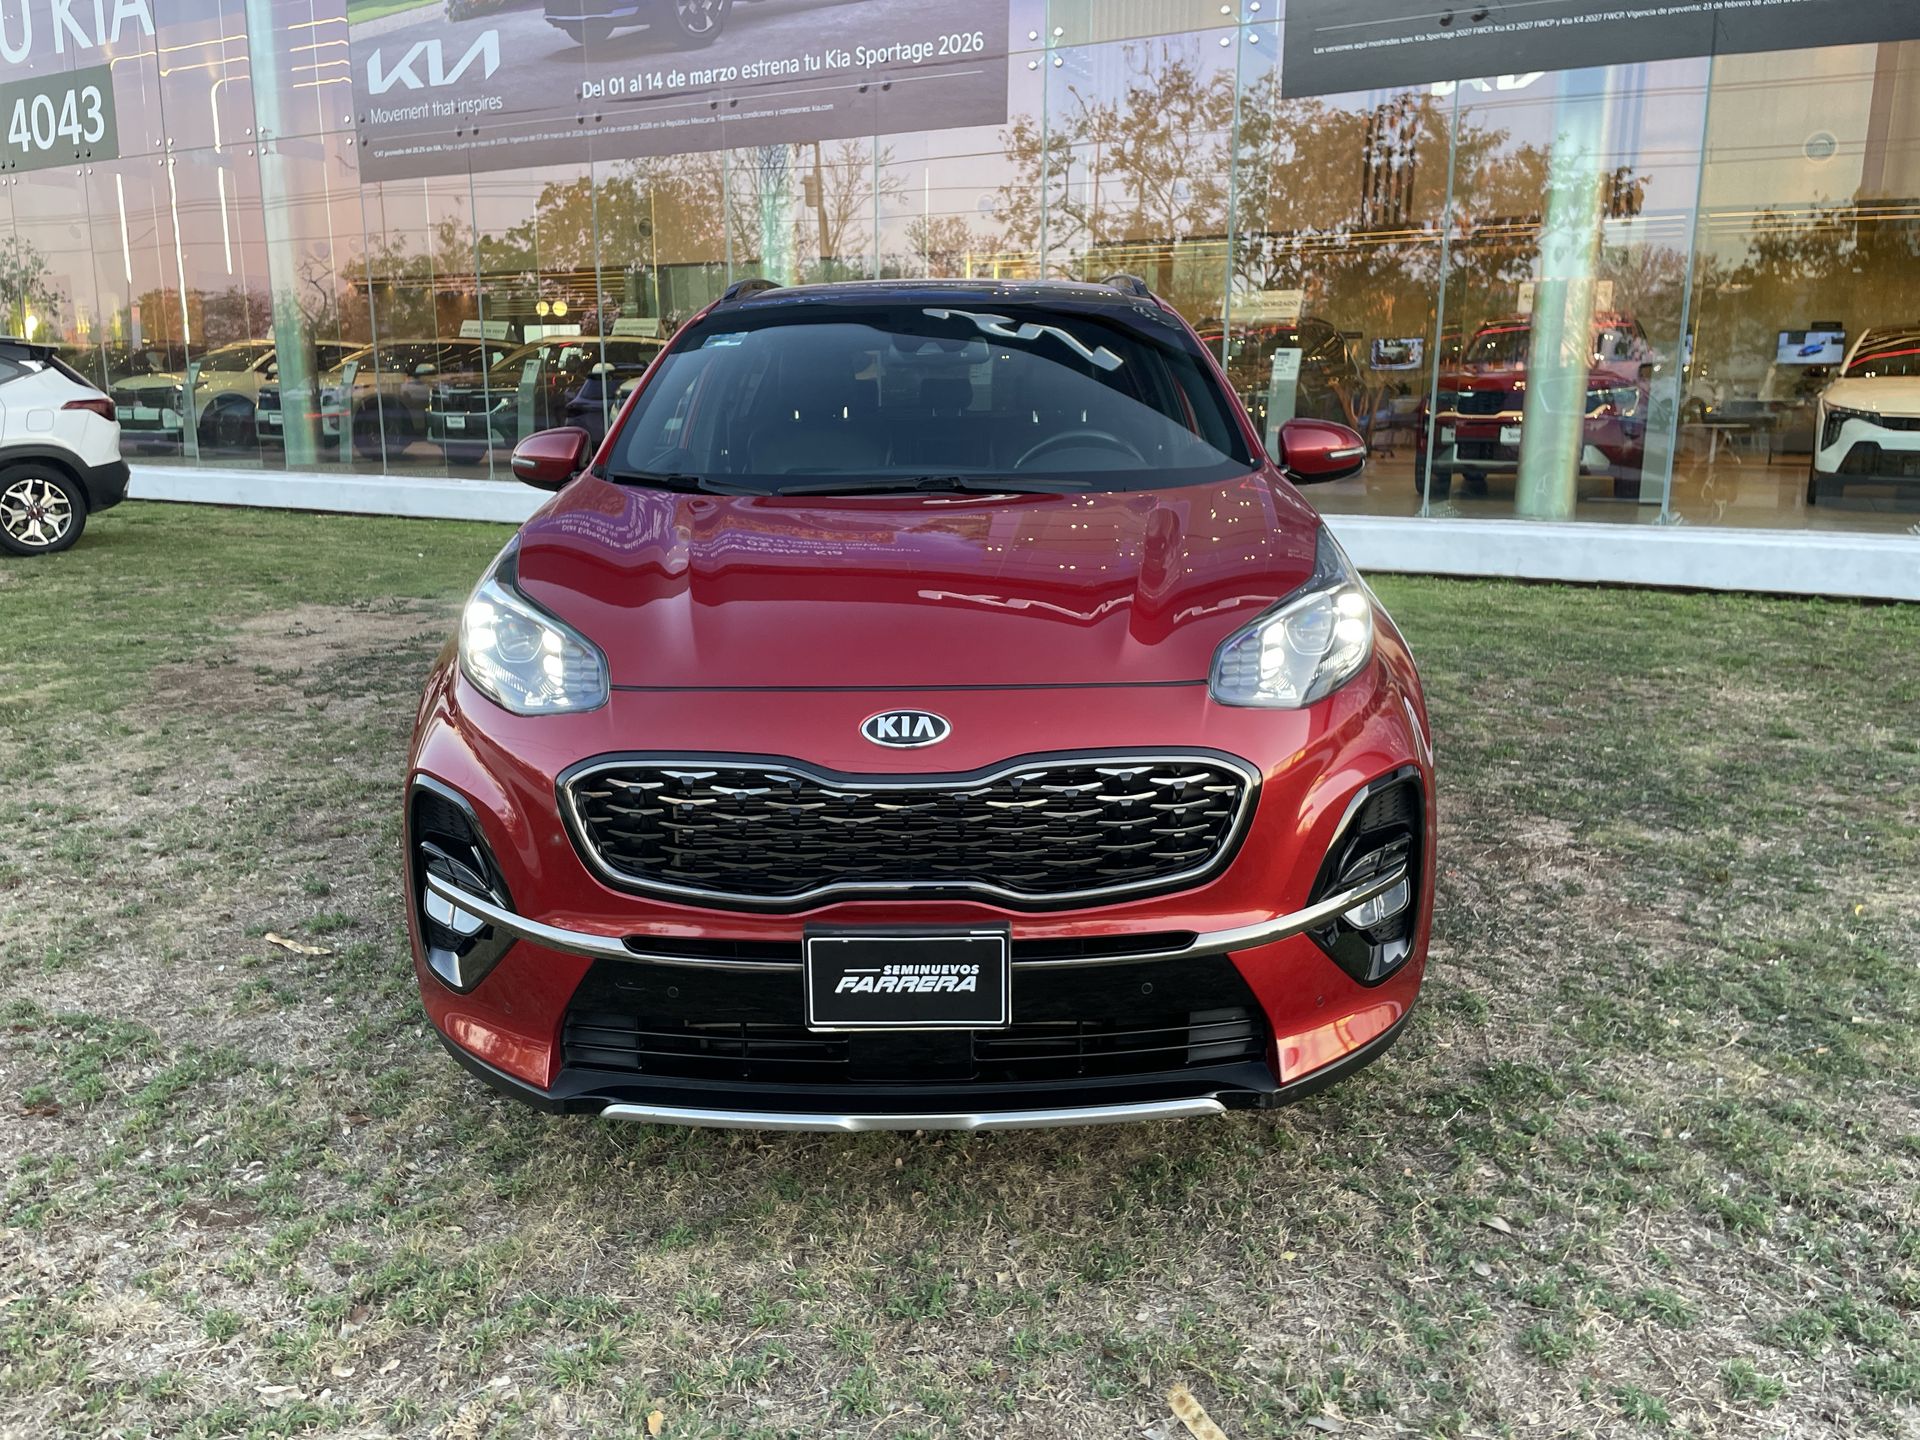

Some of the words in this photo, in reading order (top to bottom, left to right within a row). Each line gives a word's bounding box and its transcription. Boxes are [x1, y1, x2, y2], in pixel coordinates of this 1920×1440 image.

[51, 0, 155, 54] KIA
[1426, 32, 1456, 40] Sportage
[367, 30, 500, 94] KIA
[582, 78, 605, 98] Del
[609, 77, 625, 95] 01
[629, 74, 643, 92] al
[646, 72, 662, 90] 14
[667, 70, 686, 88] de
[690, 66, 737, 85] marzo
[741, 58, 800, 79] estrena
[804, 53, 821, 72] tu
[825, 49, 850, 68] Kia
[856, 42, 934, 68] Sportage
[938, 32, 984, 56] 2026
[8, 85, 104, 152] 4043
[370, 103, 429, 124] Movement
[432, 100, 455, 117] that
[457, 95, 503, 116] inspires
[877, 716, 936, 738] KIA
[882, 964, 980, 975] SEMINUEVOS
[834, 975, 977, 994] FARRERA
